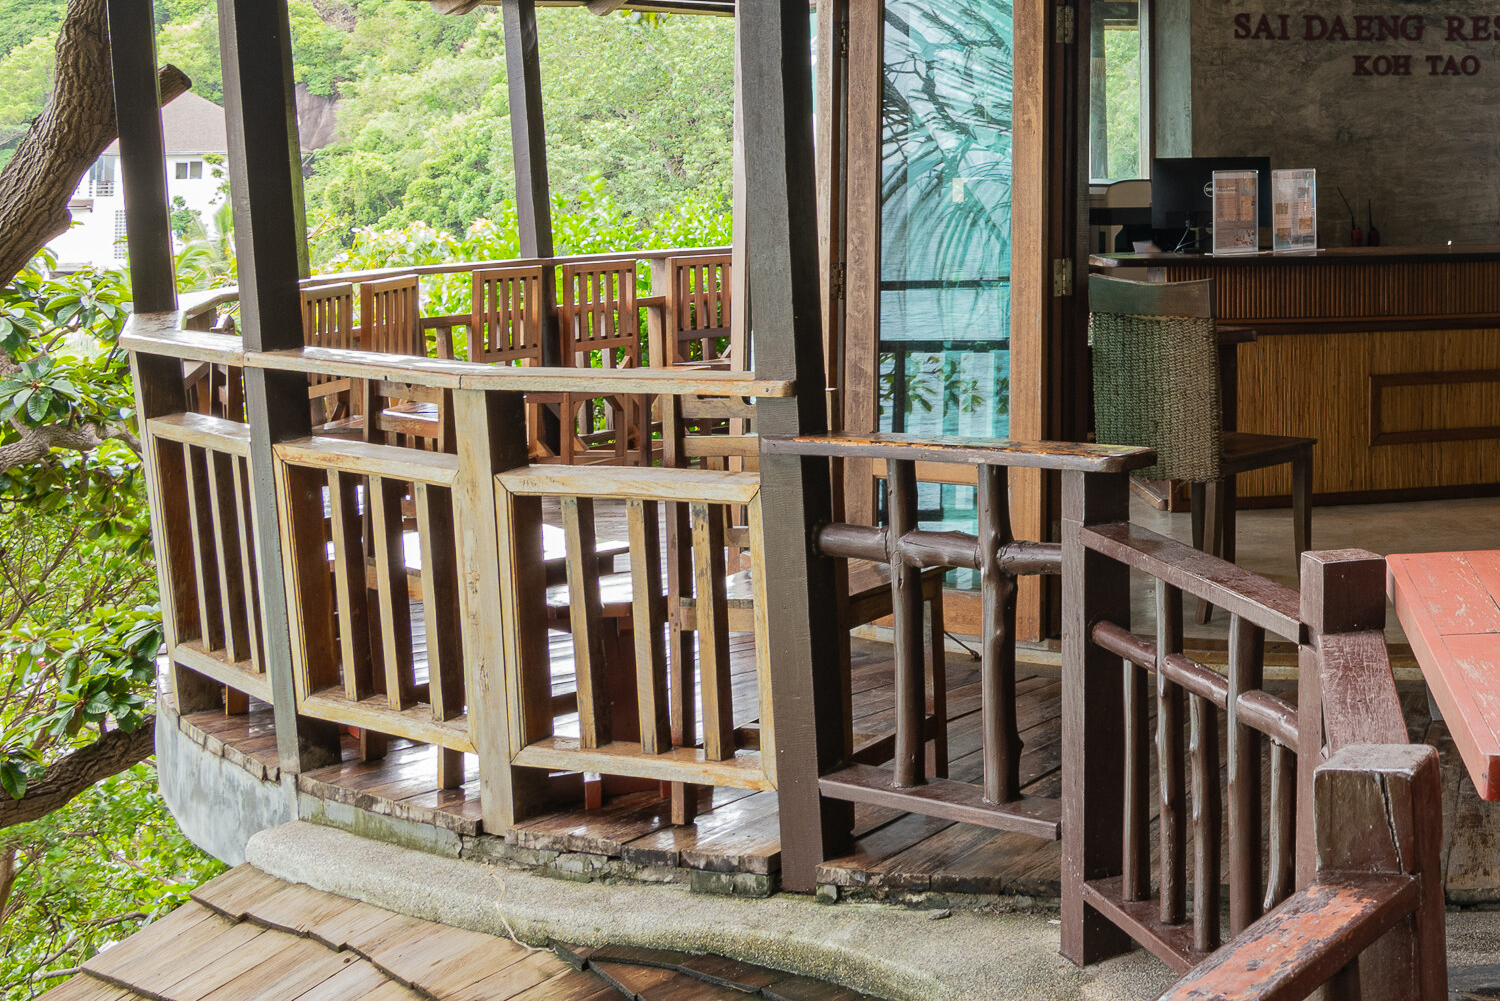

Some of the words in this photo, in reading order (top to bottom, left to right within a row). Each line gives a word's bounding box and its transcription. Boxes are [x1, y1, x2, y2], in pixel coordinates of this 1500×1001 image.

[1234, 13, 1290, 40] SAI
[1303, 14, 1426, 41] DAENG
[1352, 55, 1412, 76] KOH
[1425, 55, 1481, 76] TAO
